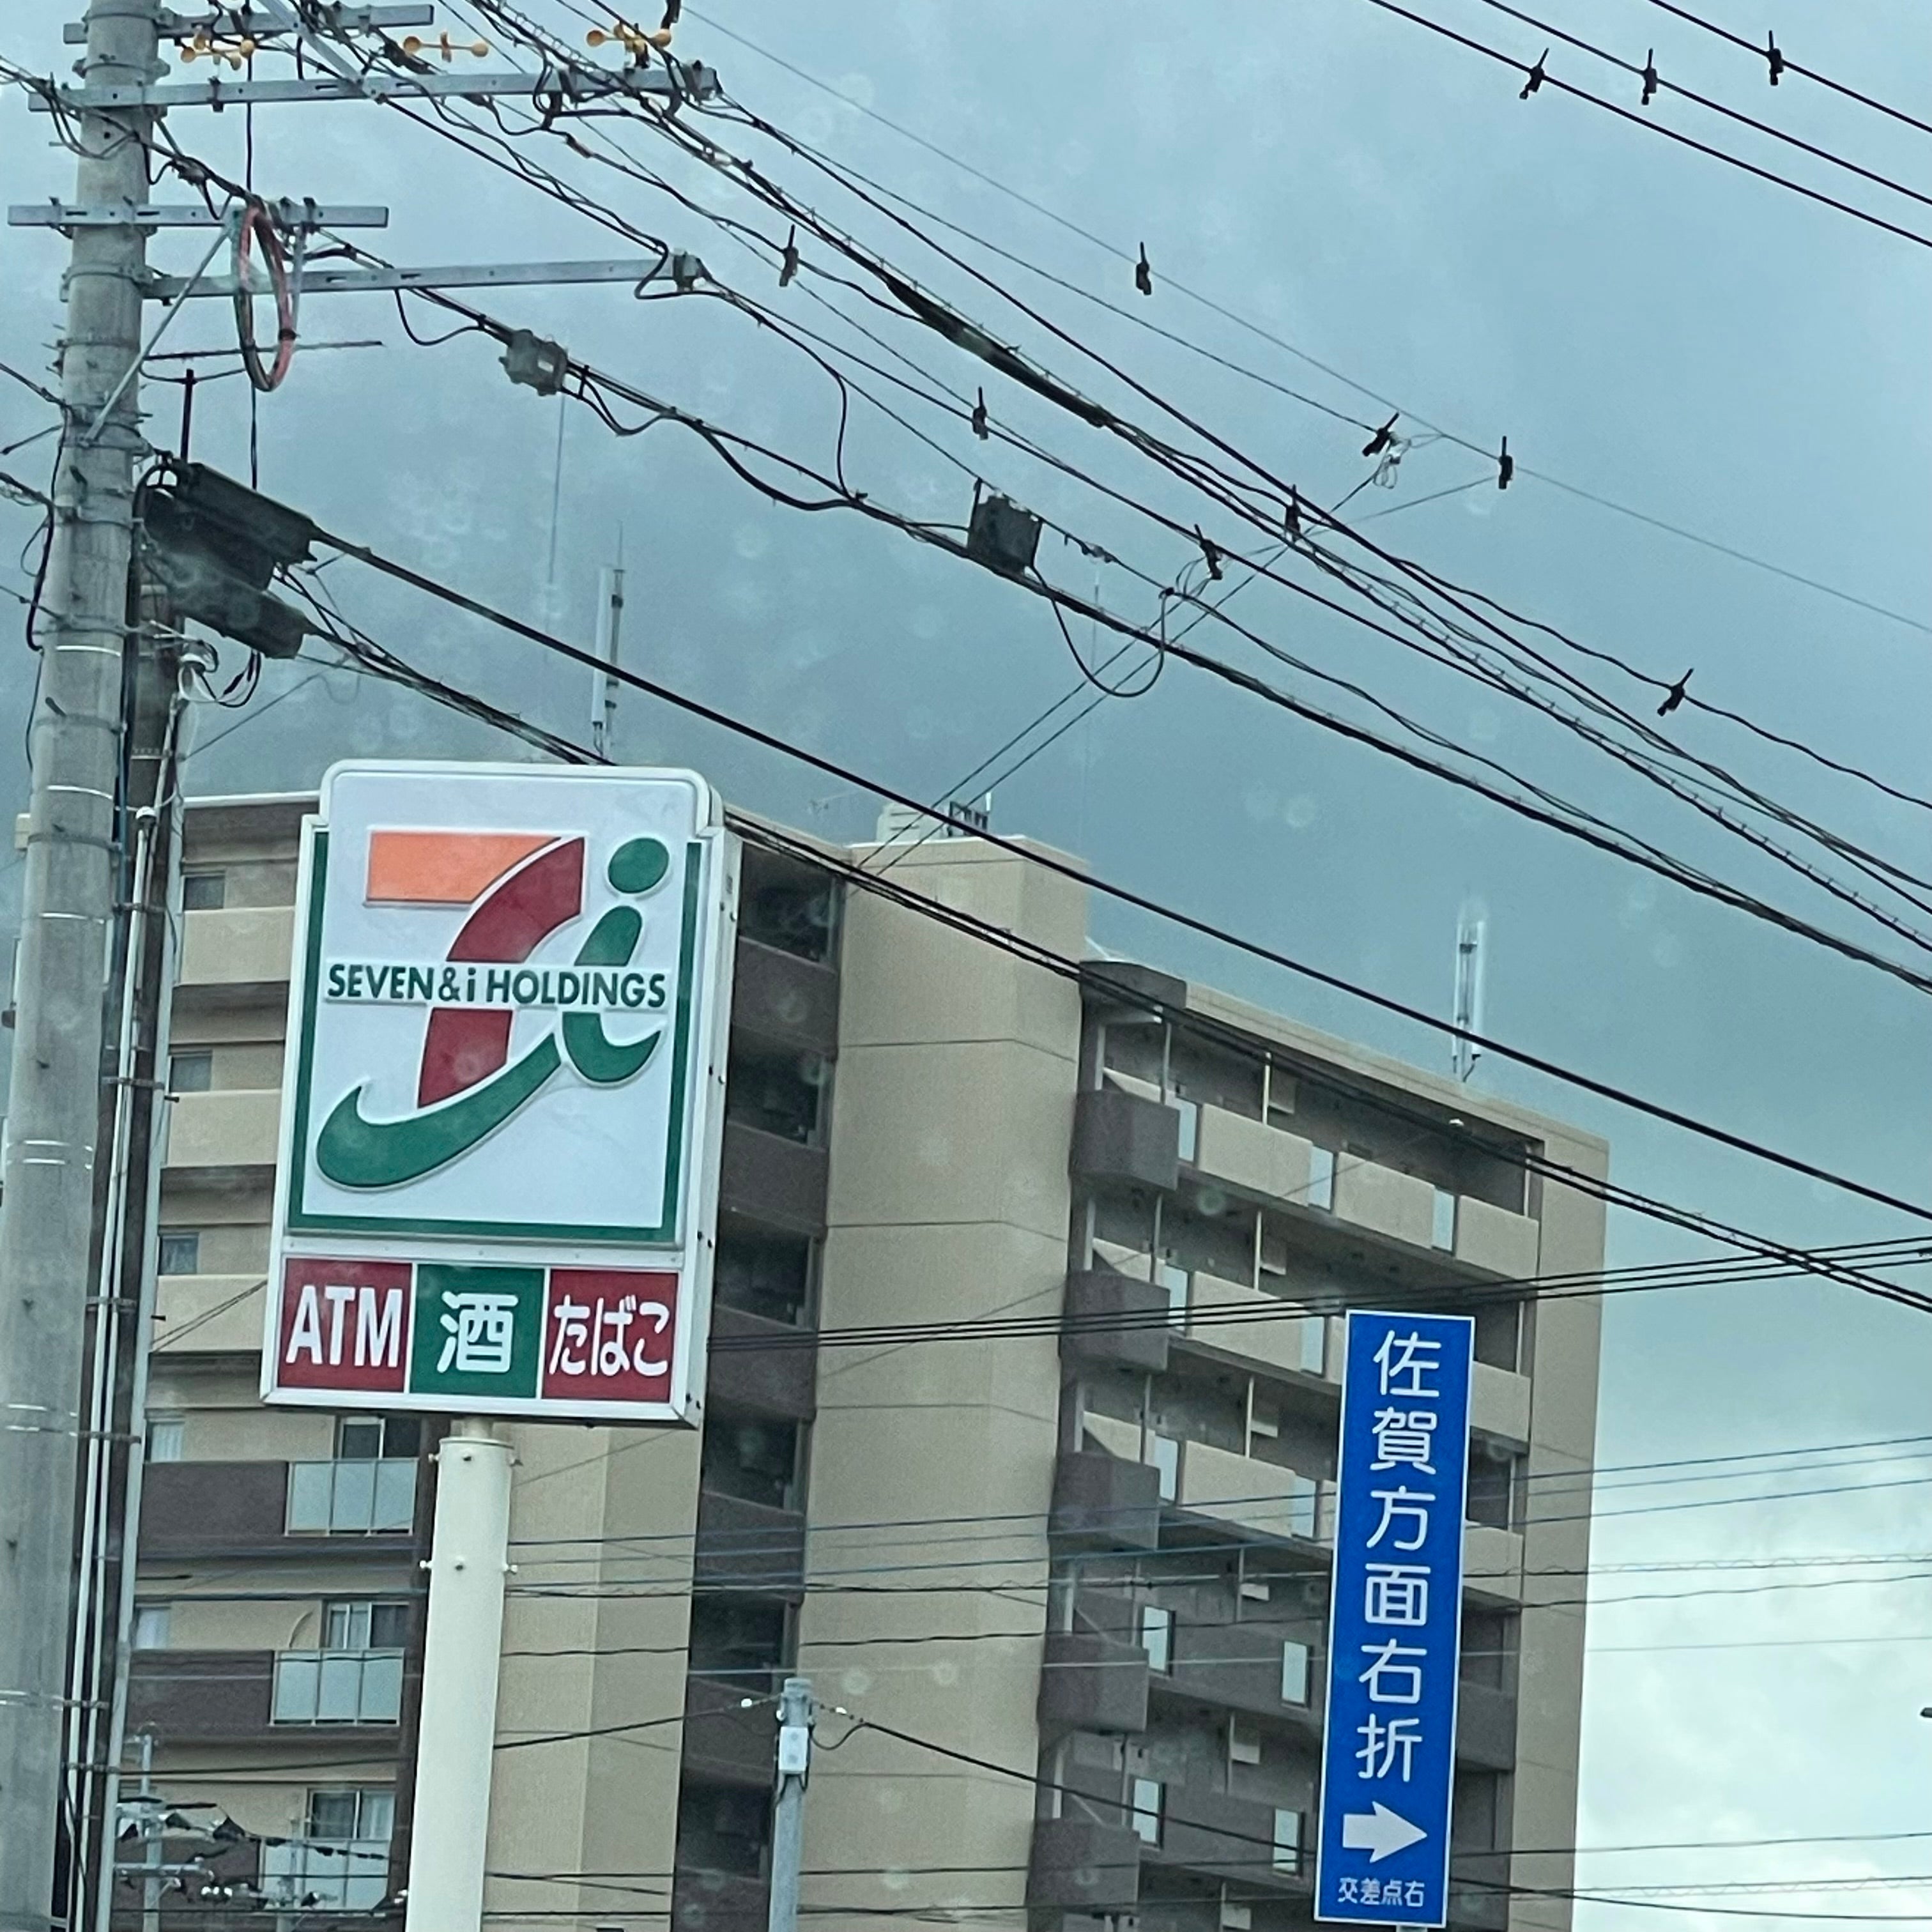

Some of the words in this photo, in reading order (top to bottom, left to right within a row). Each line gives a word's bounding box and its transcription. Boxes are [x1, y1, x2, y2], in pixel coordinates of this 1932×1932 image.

[486, 969, 666, 1008] HOLDINGS
[285, 1284, 404, 1368] ATM
[436, 1291, 519, 1374] 酒
[548, 1294, 670, 1377] たばこ
[1354, 1329, 1442, 1783] 佐賀方面右折
[1337, 1876, 1425, 1908] 交差点右
